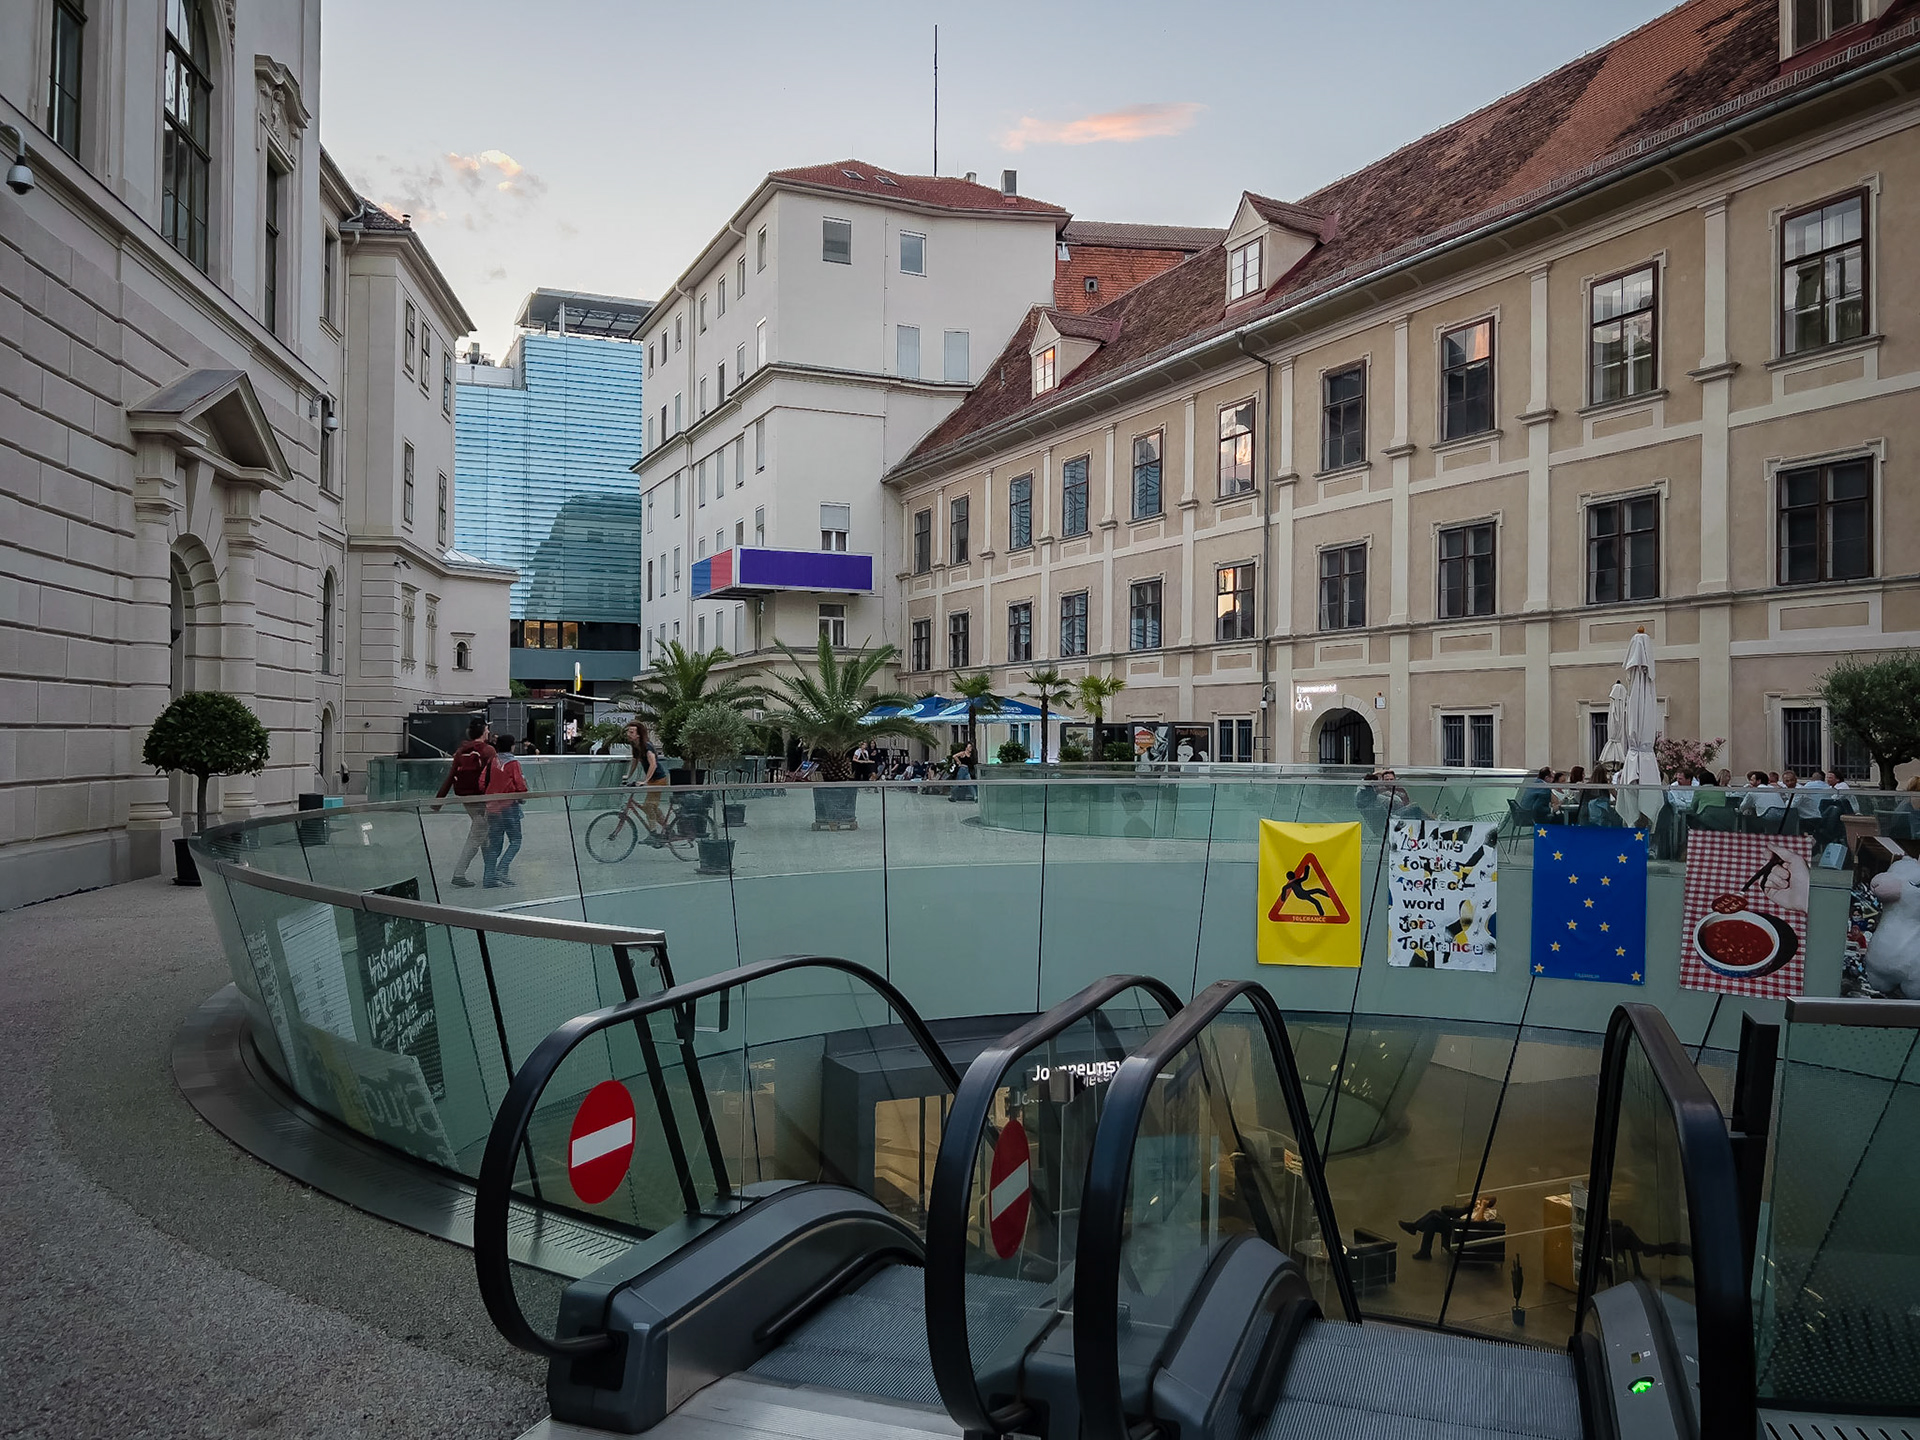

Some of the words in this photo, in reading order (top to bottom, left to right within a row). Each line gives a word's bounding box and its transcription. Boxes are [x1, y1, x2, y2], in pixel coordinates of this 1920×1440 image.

[1402, 898, 1445, 911] word
[1292, 915, 1327, 923] TOLERANCE
[1397, 935, 1484, 955] Tolerance
